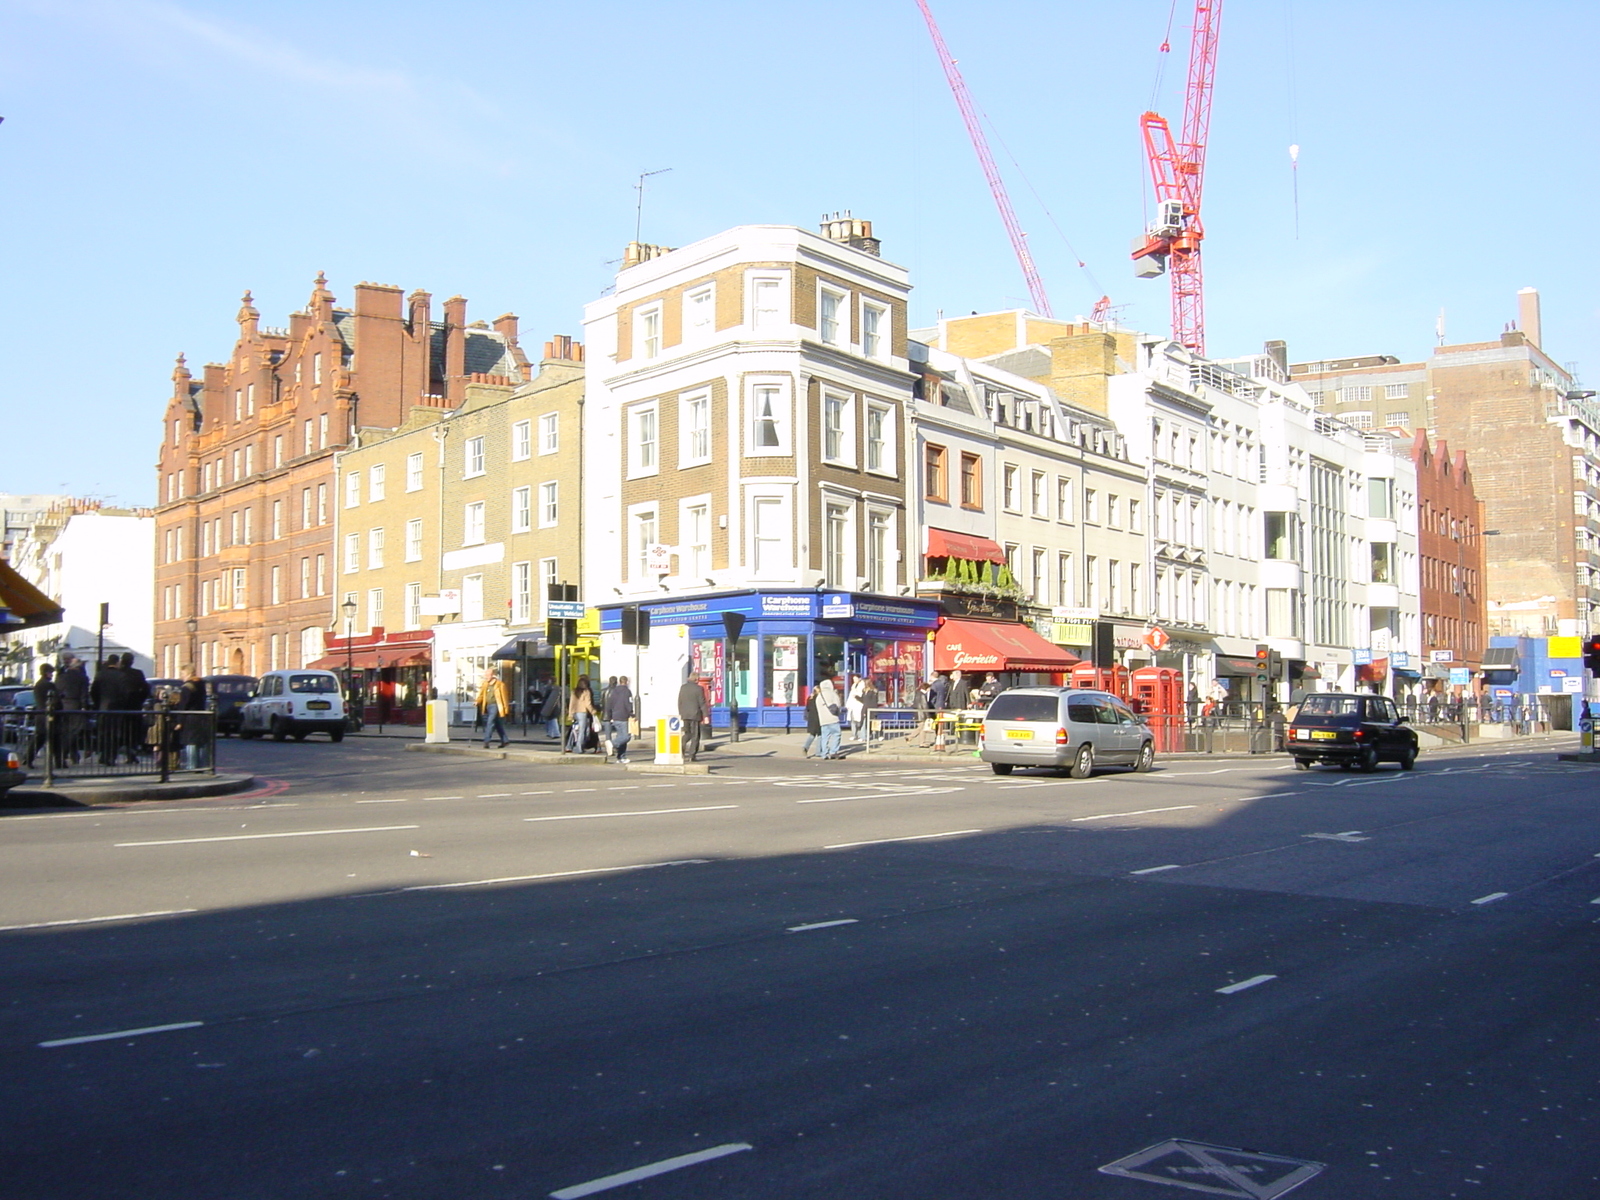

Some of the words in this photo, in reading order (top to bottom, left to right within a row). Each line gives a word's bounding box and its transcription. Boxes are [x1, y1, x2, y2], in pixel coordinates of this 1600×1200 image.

[767, 596, 810, 606] Carphone
[953, 652, 998, 669] Gloriette
[778, 681, 794, 692] £50
